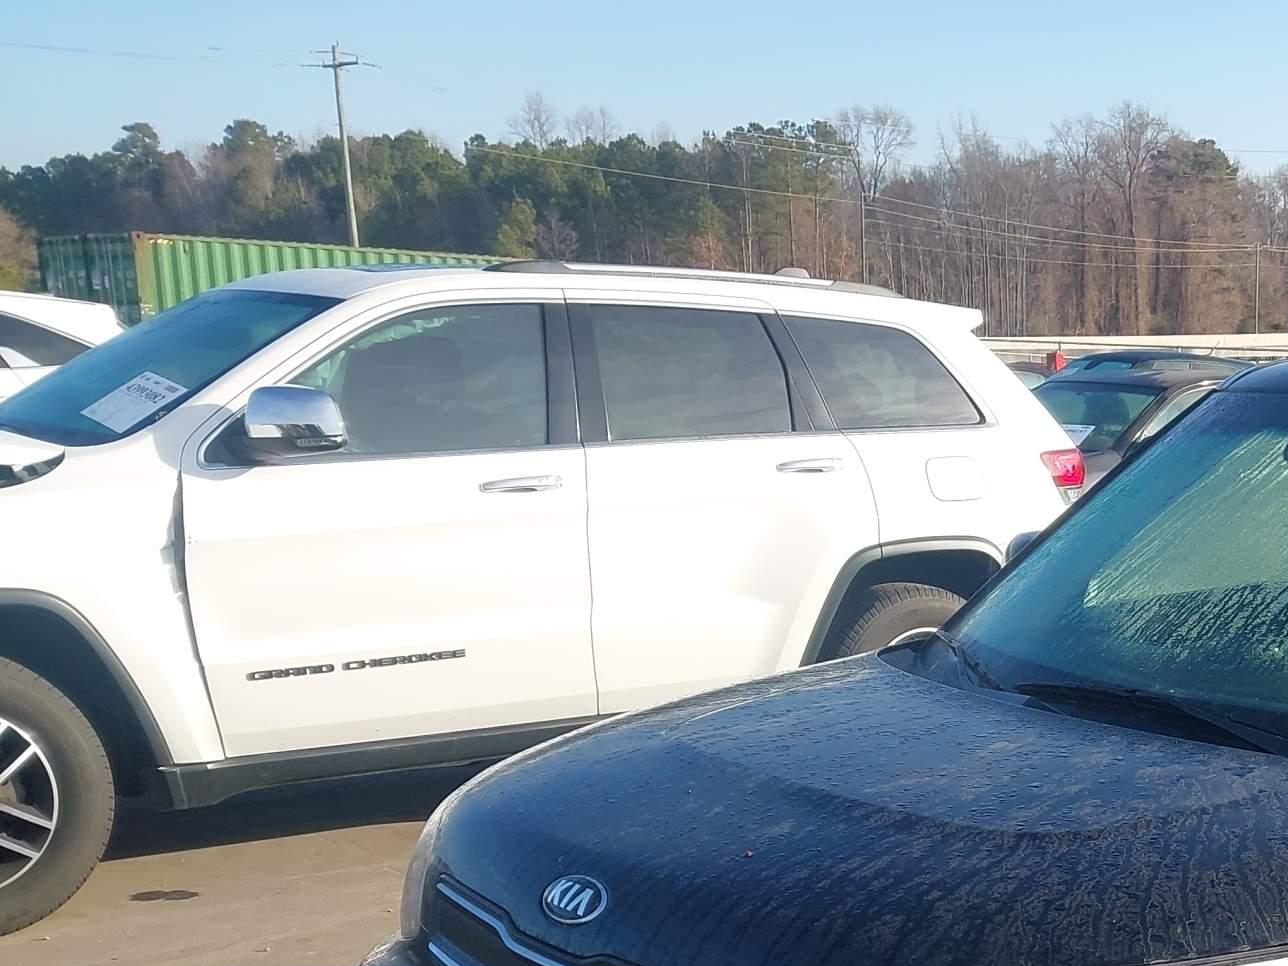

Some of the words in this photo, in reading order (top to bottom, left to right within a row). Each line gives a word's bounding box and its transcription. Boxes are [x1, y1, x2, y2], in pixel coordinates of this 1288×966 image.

[245, 663, 335, 682] GRAND
[341, 648, 467, 672] CHEROKEE
[546, 879, 594, 917] KIA
